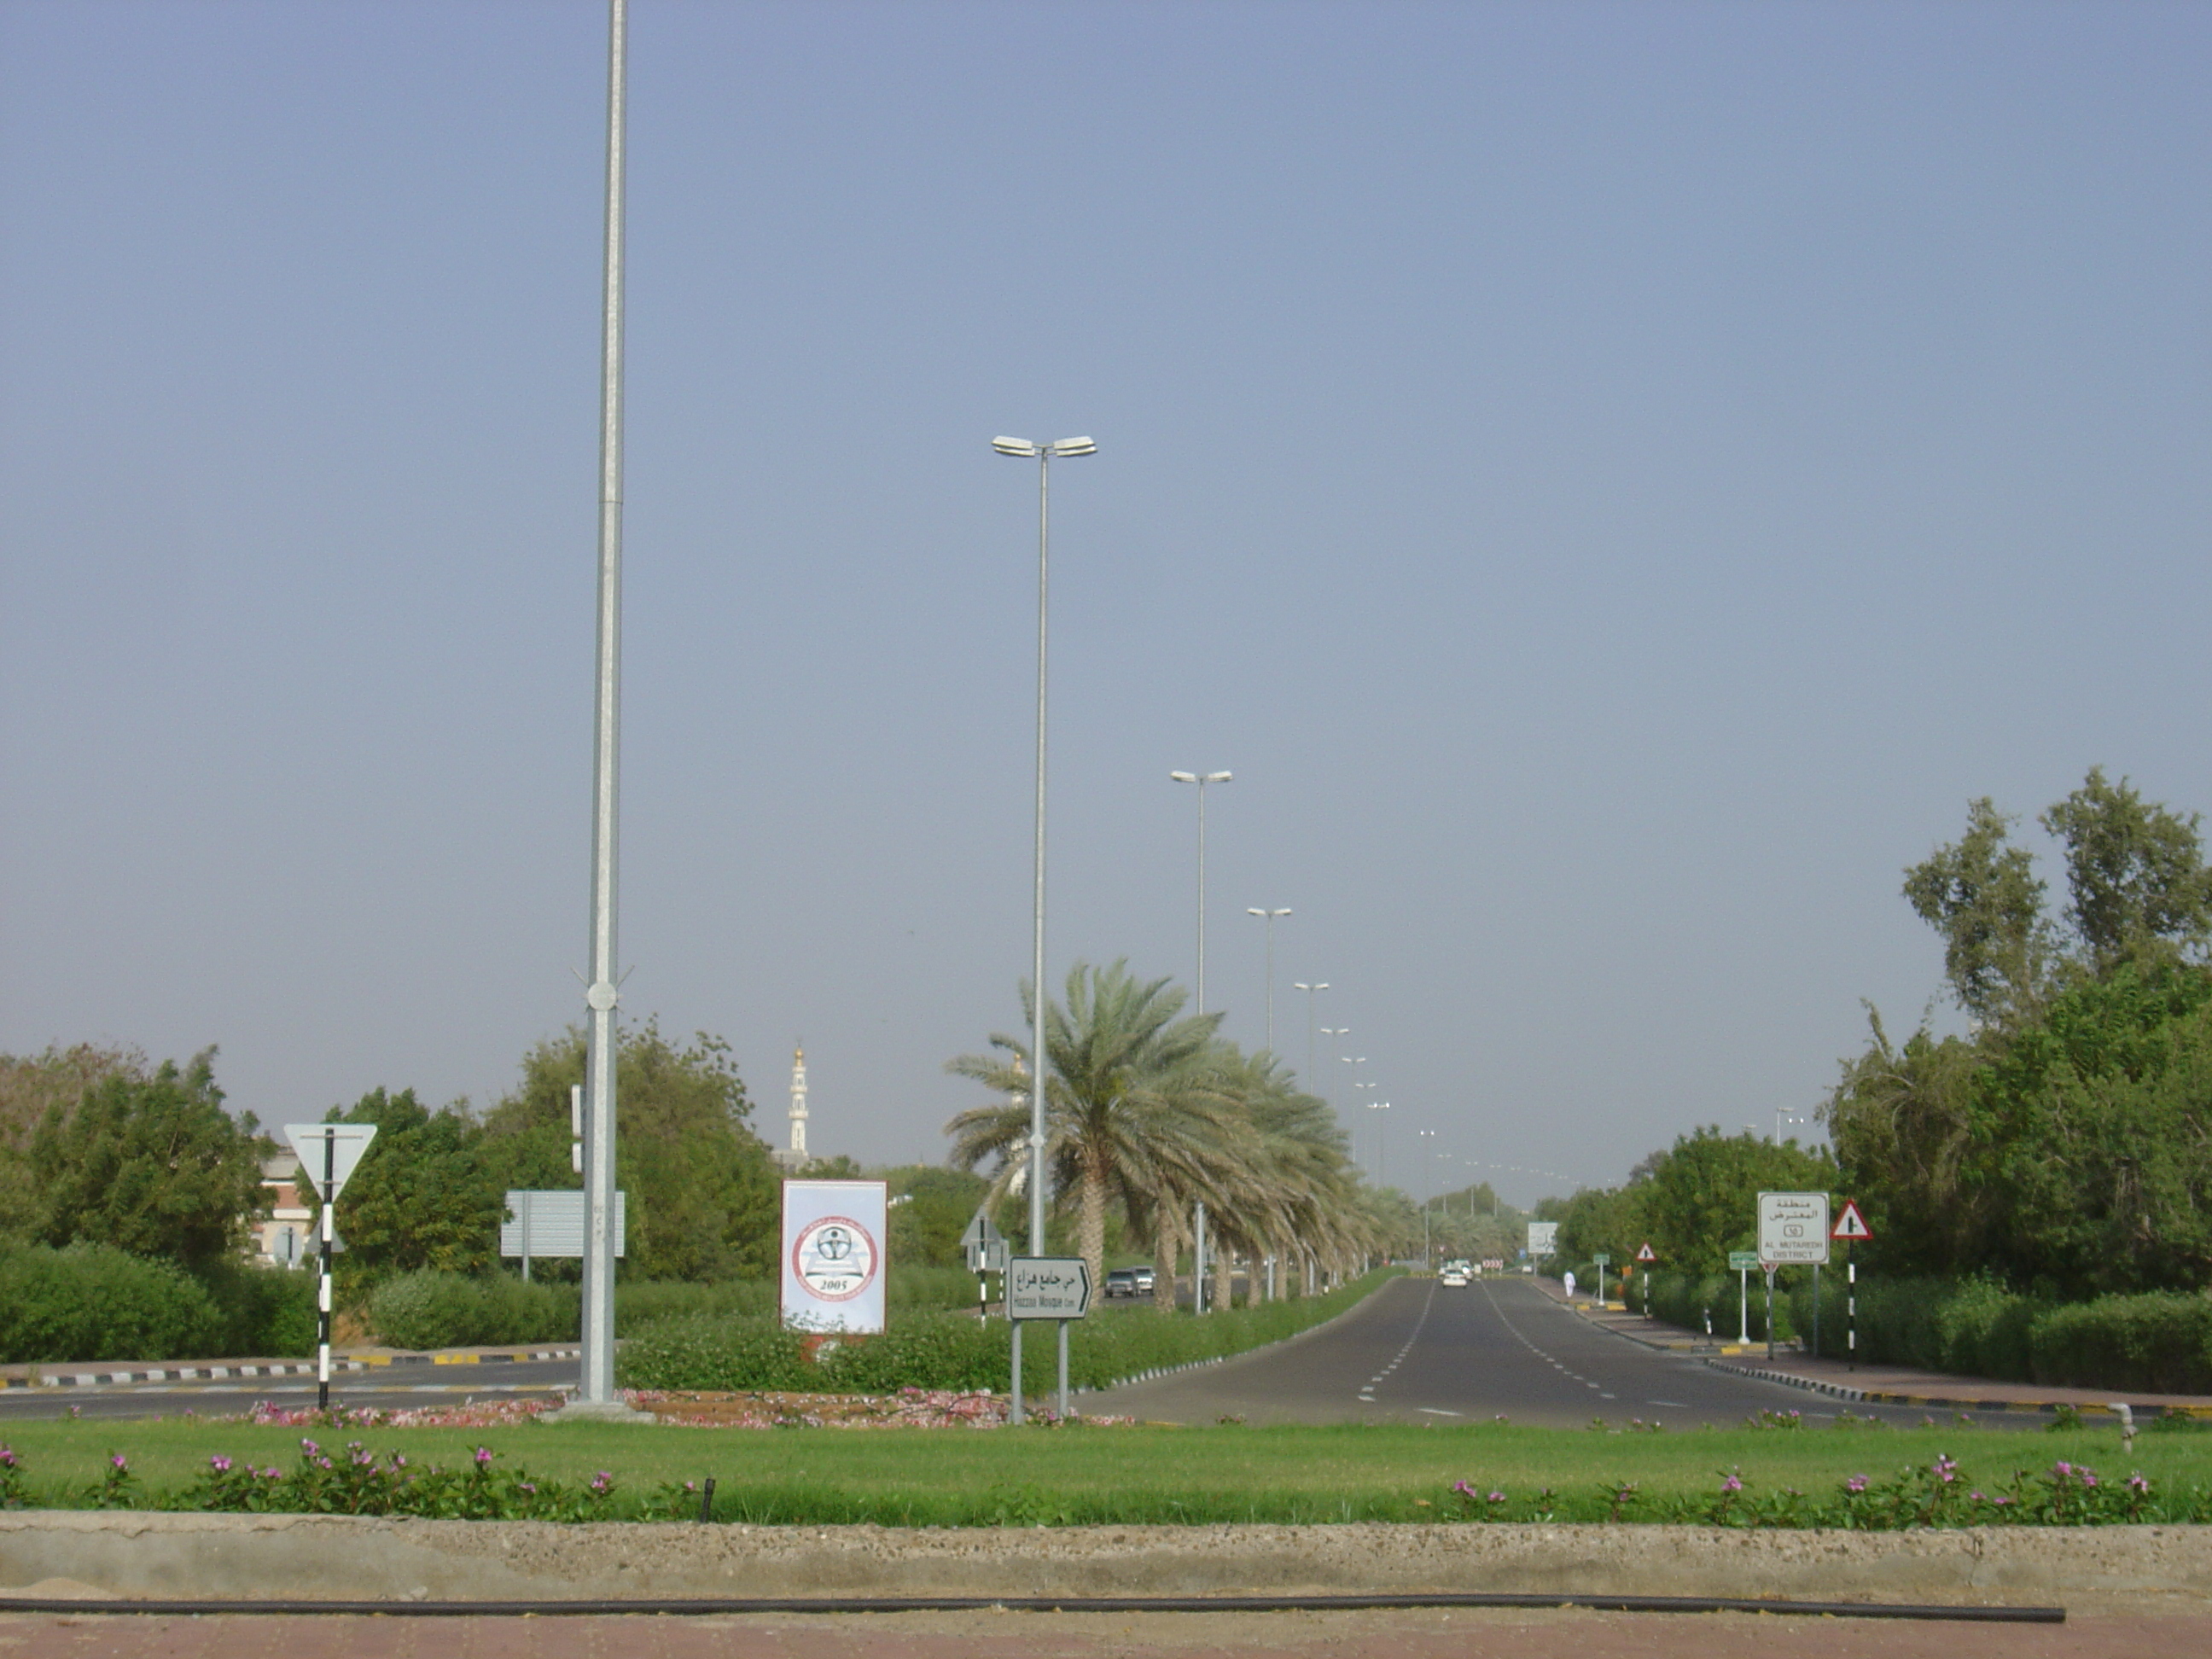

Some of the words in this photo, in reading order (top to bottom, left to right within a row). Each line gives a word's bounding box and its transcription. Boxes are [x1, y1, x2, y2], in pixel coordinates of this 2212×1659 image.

[820, 1279, 847, 1291] 2005
[1017, 1268, 1037, 1291] هزاع
[1039, 1269, 1061, 1290] جامع
[1063, 1277, 1075, 1292] حي
[1039, 1295, 1062, 1310] Mosque
